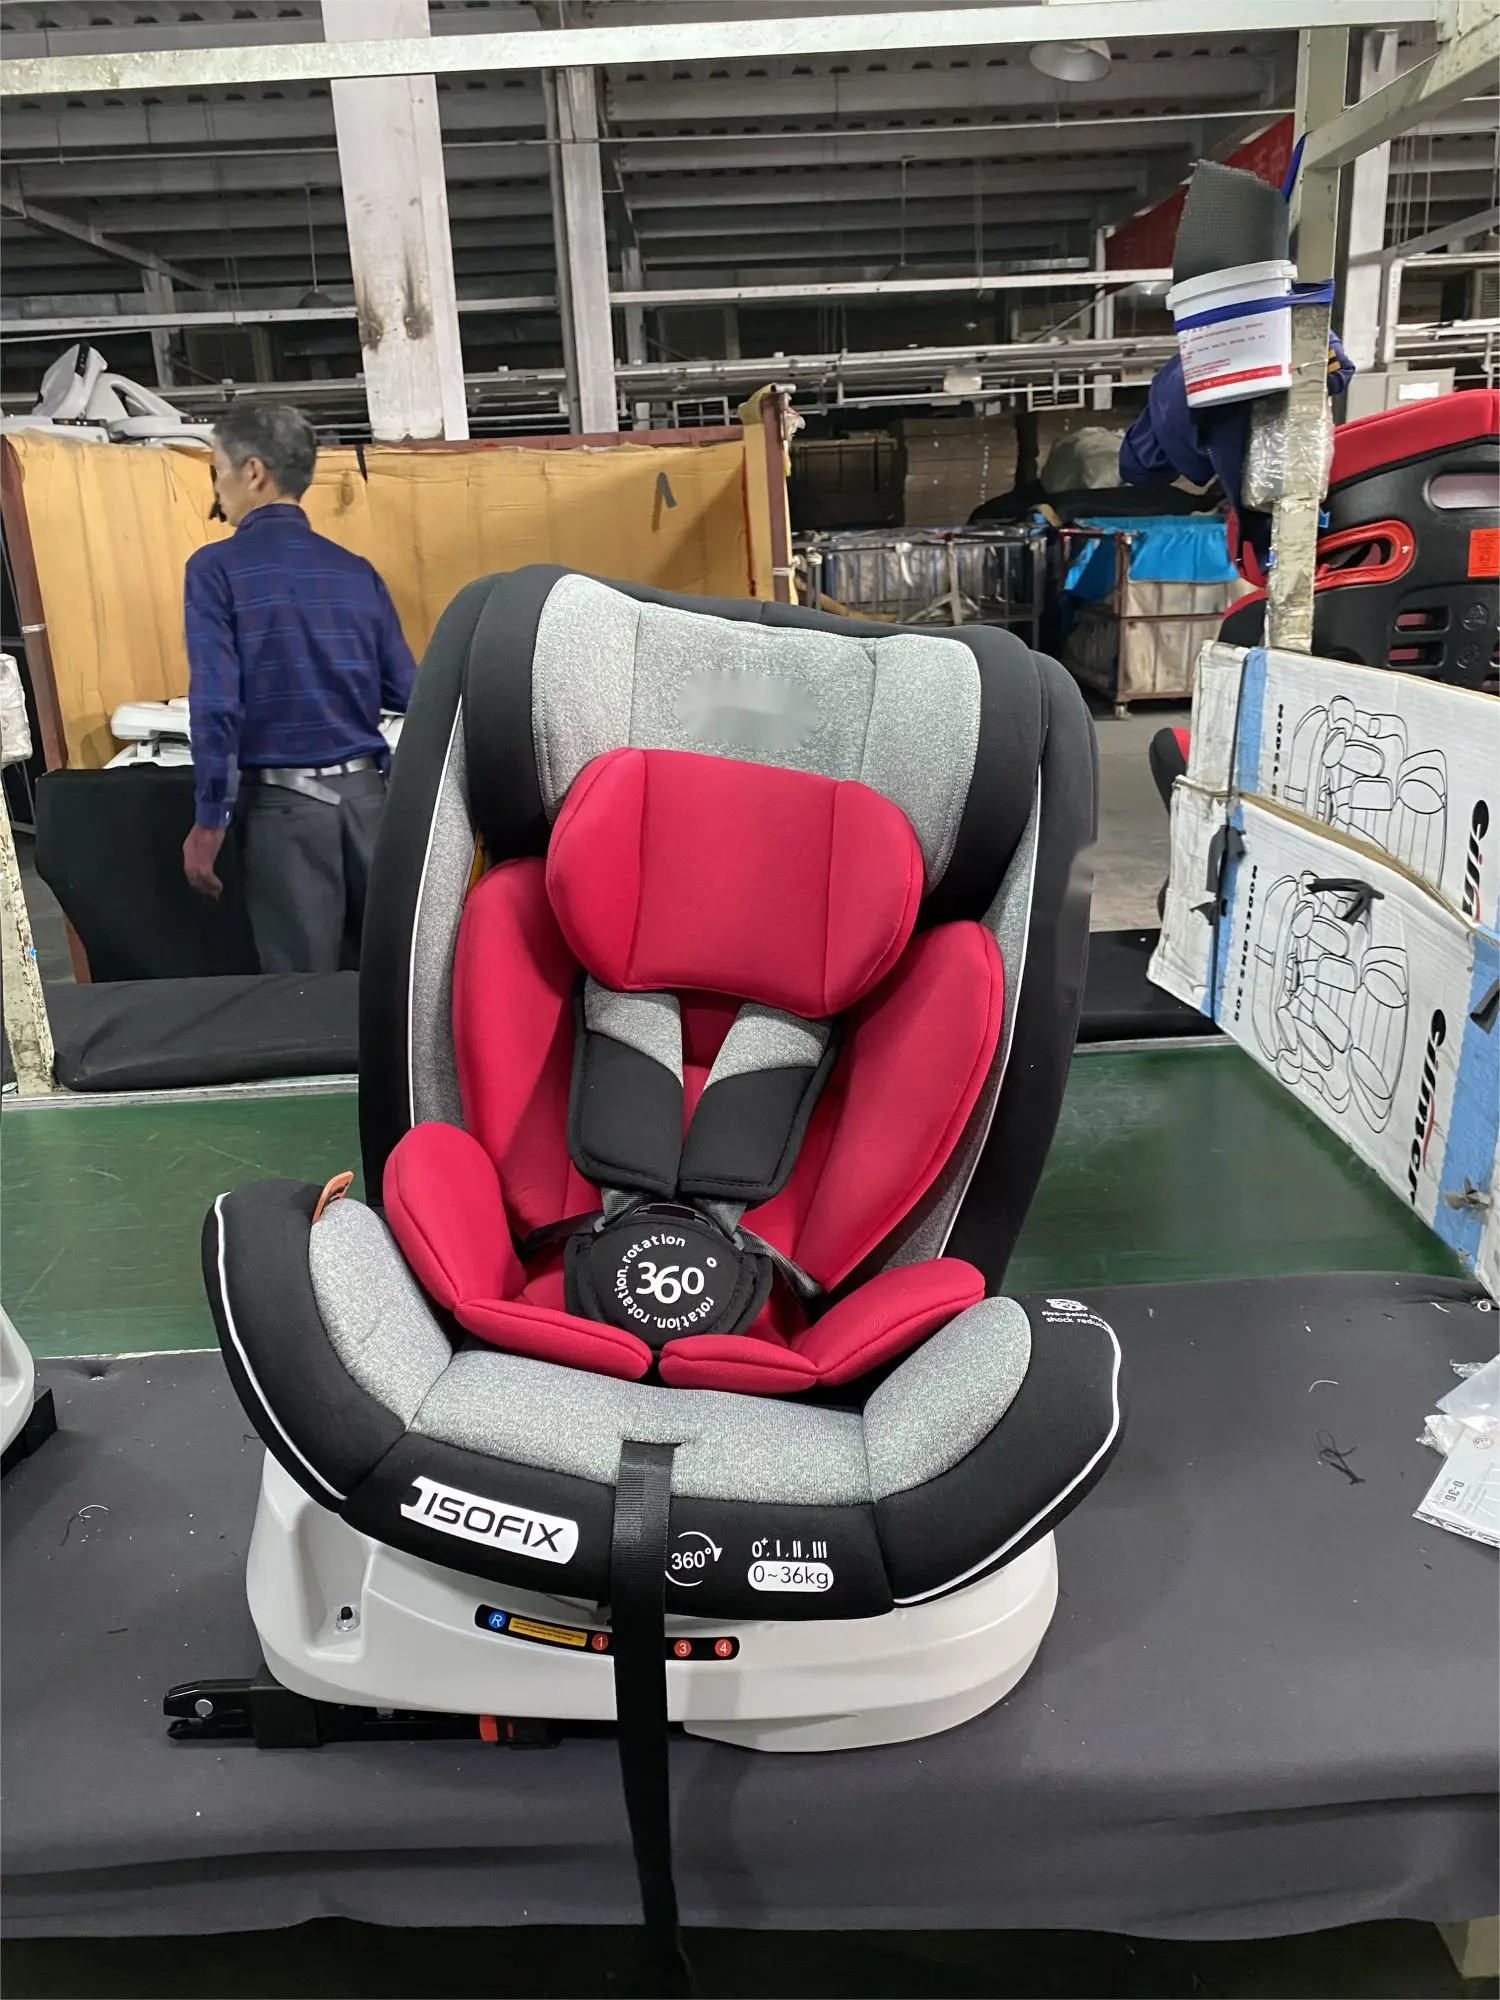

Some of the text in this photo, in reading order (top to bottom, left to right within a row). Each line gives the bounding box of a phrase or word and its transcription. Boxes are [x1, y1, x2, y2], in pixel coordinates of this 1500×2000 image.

[1444, 1480, 1465, 1502] 0-36
[419, 1492, 564, 1553] ISOFIX
[491, 1614, 503, 1627] R
[679, 1642, 688, 1654] 3
[719, 1642, 728, 1654] 4
